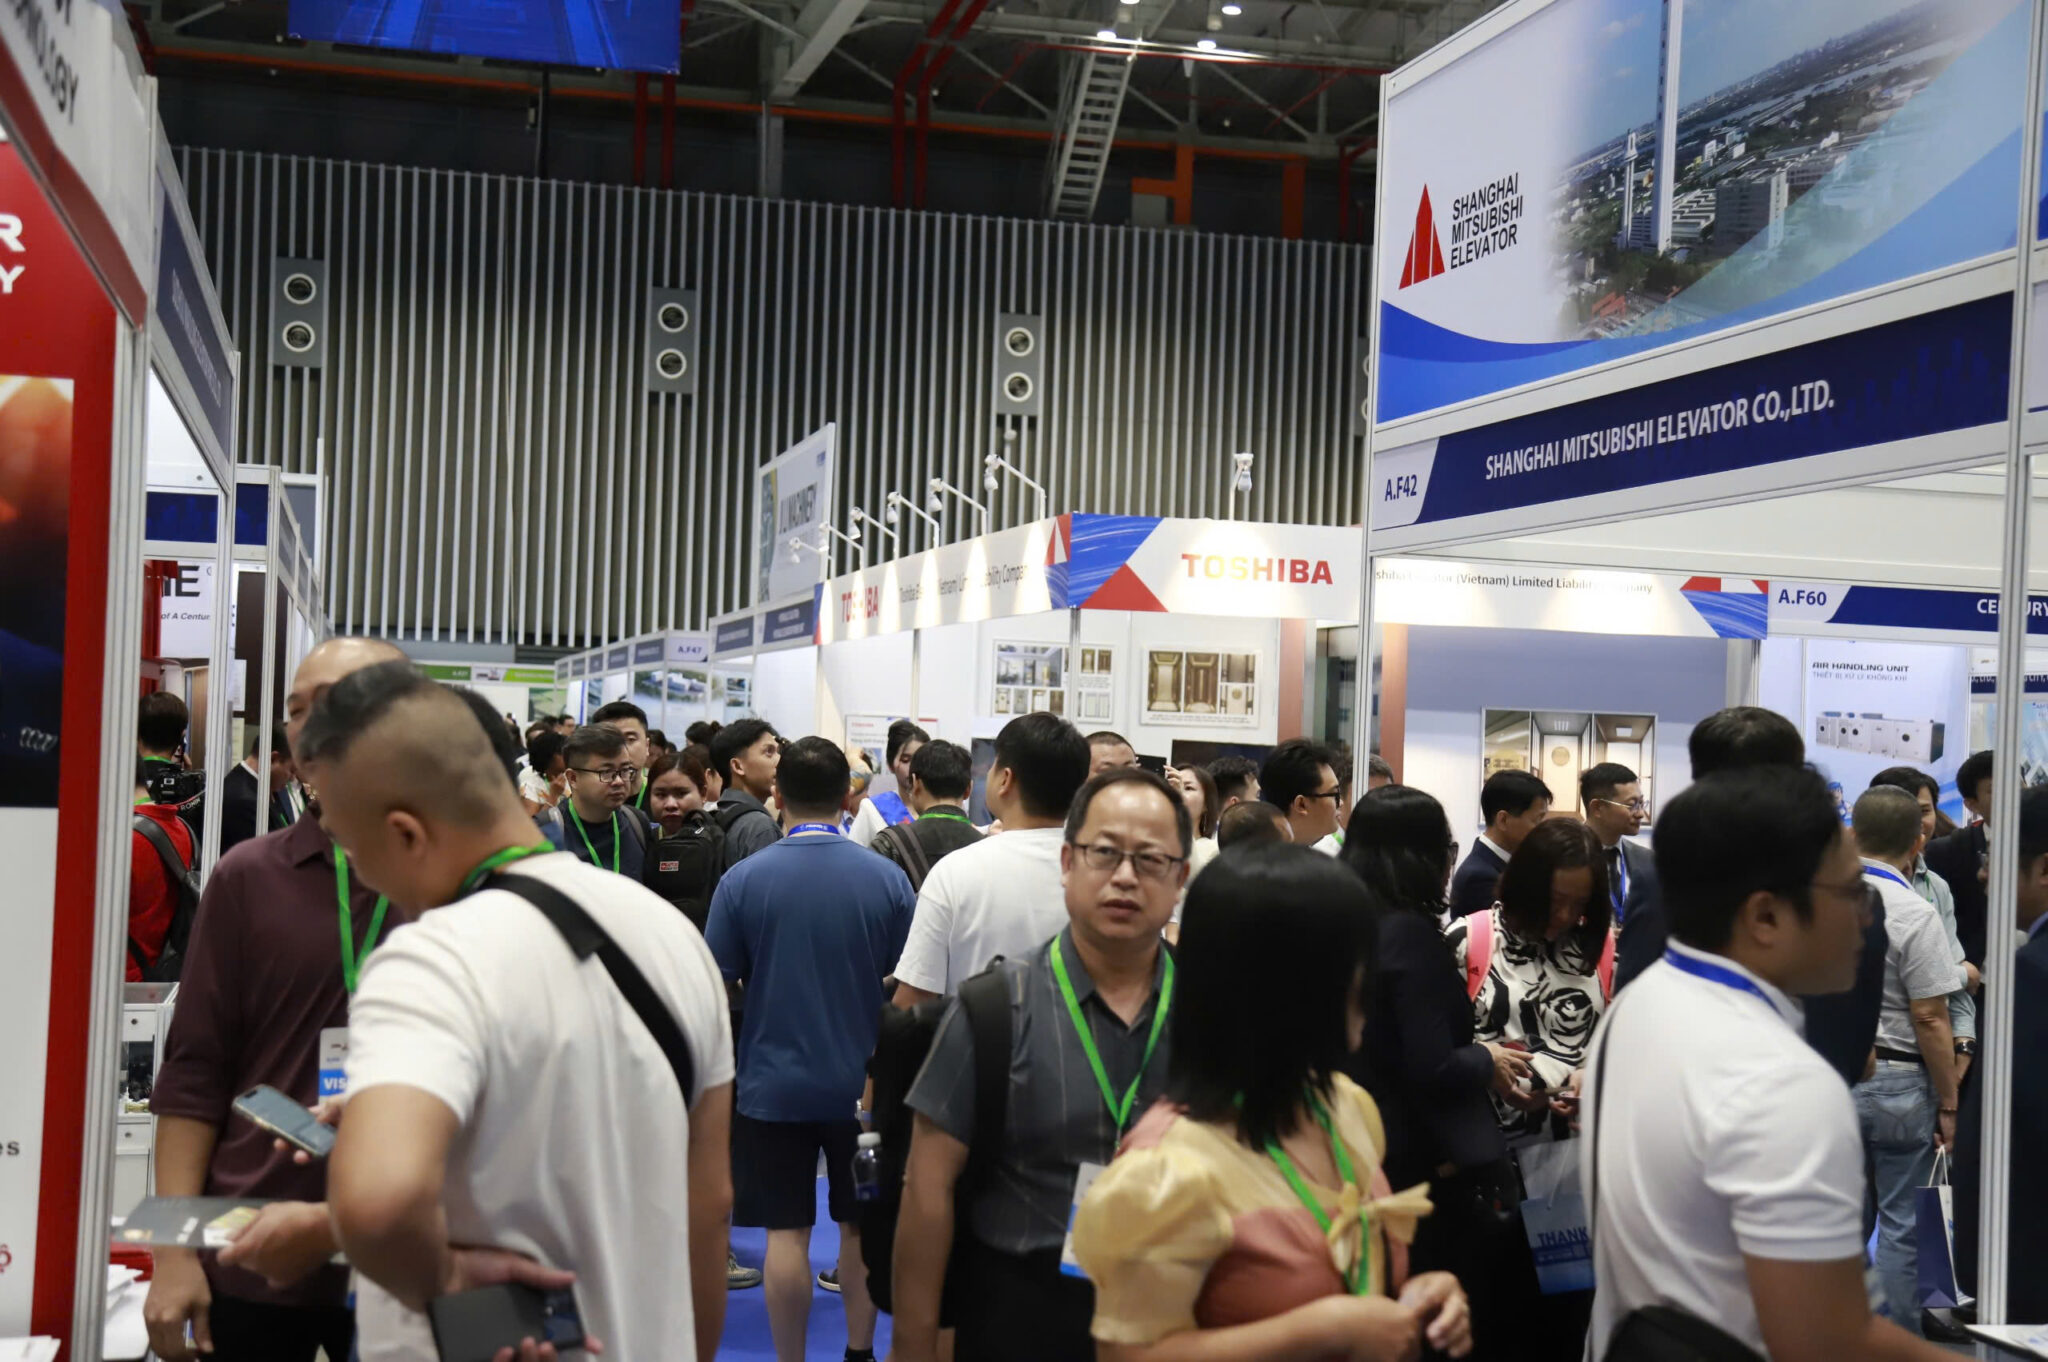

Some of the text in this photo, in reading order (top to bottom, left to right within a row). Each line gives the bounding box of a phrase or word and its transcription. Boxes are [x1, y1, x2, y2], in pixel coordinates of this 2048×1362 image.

[1452, 172, 1519, 221] SHANGHAI
[1451, 196, 1523, 246] MITSUBISHI
[1450, 223, 1518, 270] ELEVATOR
[1485, 440, 1559, 480] SHANGHAI
[1562, 419, 1654, 465] MITSUBISHI
[1657, 398, 1749, 445] ELEVATOR
[1384, 474, 1418, 502] A.F42
[1181, 553, 1333, 585] TOSHIBA
[1456, 572, 1509, 588] (Vietnam)
[1512, 574, 1554, 589] Limited
[1556, 577, 1594, 592] Liabilit
[841, 584, 880, 624] TOIBA
[1778, 588, 1827, 606] A.F60
[1812, 661, 1909, 673] AIR HANDLING UNIT
